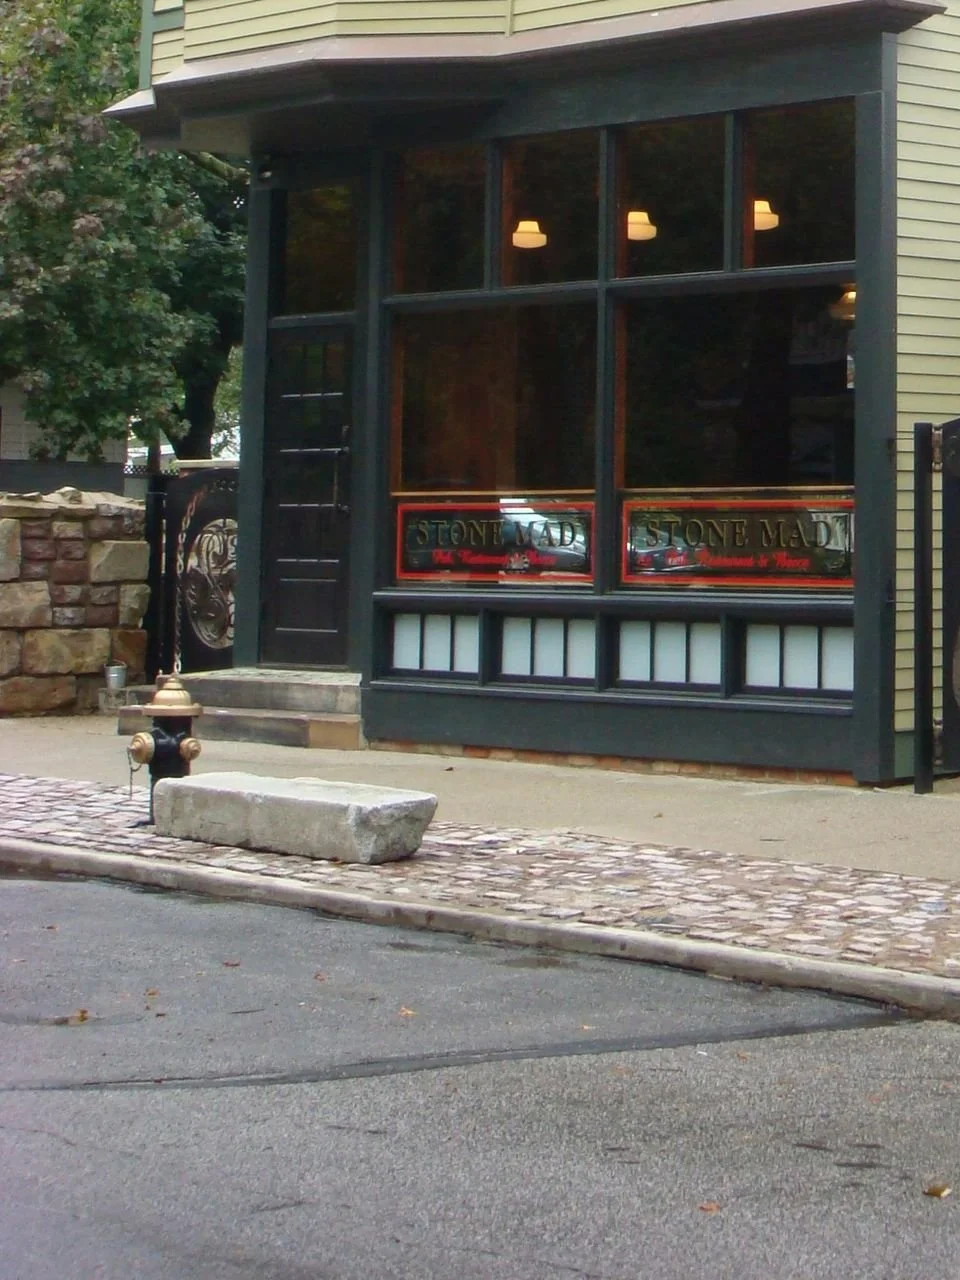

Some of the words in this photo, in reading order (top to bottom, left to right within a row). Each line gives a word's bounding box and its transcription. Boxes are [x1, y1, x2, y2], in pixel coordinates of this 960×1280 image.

[416, 519, 505, 546] STONE
[514, 520, 576, 548] MAD
[645, 518, 748, 548] STONE
[759, 518, 833, 549] MAD
